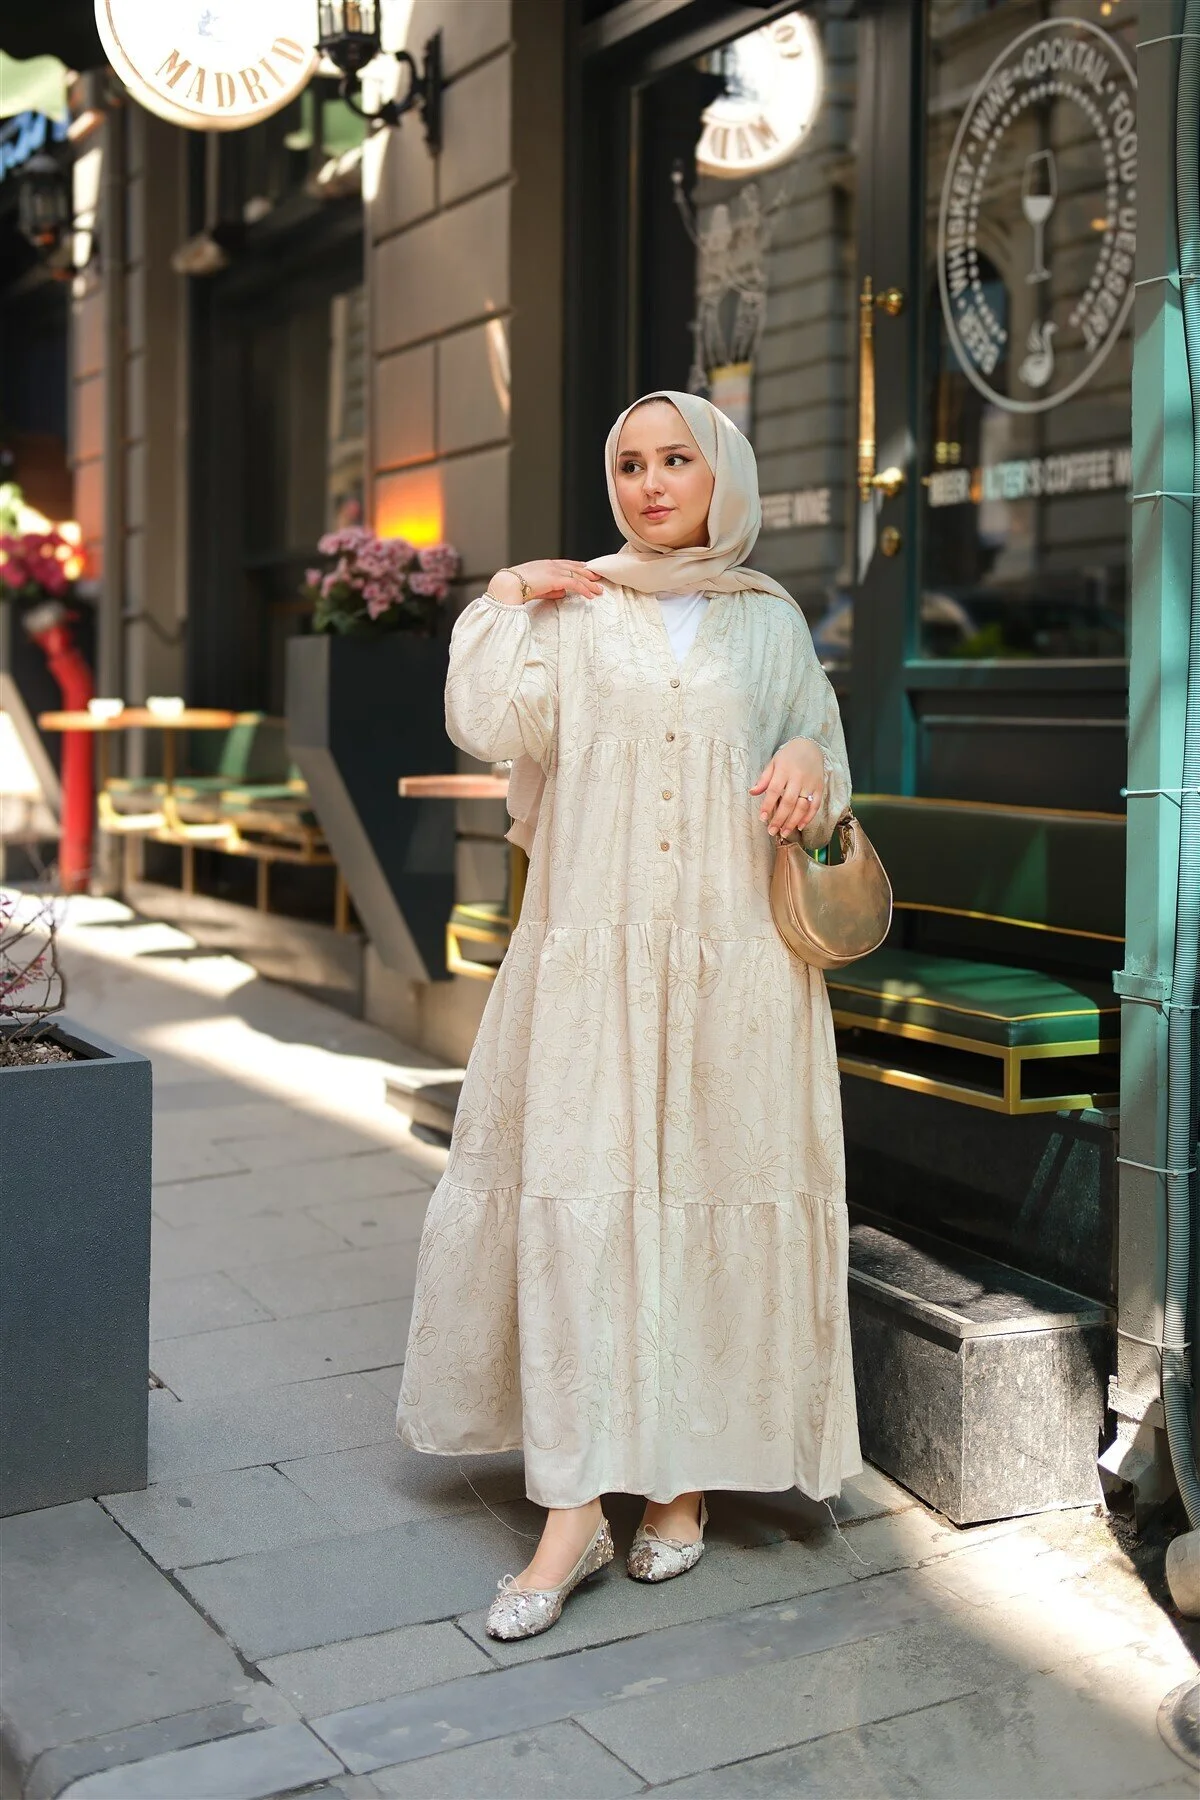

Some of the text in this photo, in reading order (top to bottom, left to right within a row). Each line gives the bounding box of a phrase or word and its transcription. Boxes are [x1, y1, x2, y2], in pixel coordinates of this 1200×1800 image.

[155, 37, 305, 107] MADRID
[1022, 37, 1110, 95] COCKTAIL
[969, 68, 1016, 141] WINE
[947, 154, 976, 299] WHISKEY
[958, 304, 999, 375] BEER
[793, 486, 831, 526] WINE
[1044, 450, 1112, 495] COFFEE
